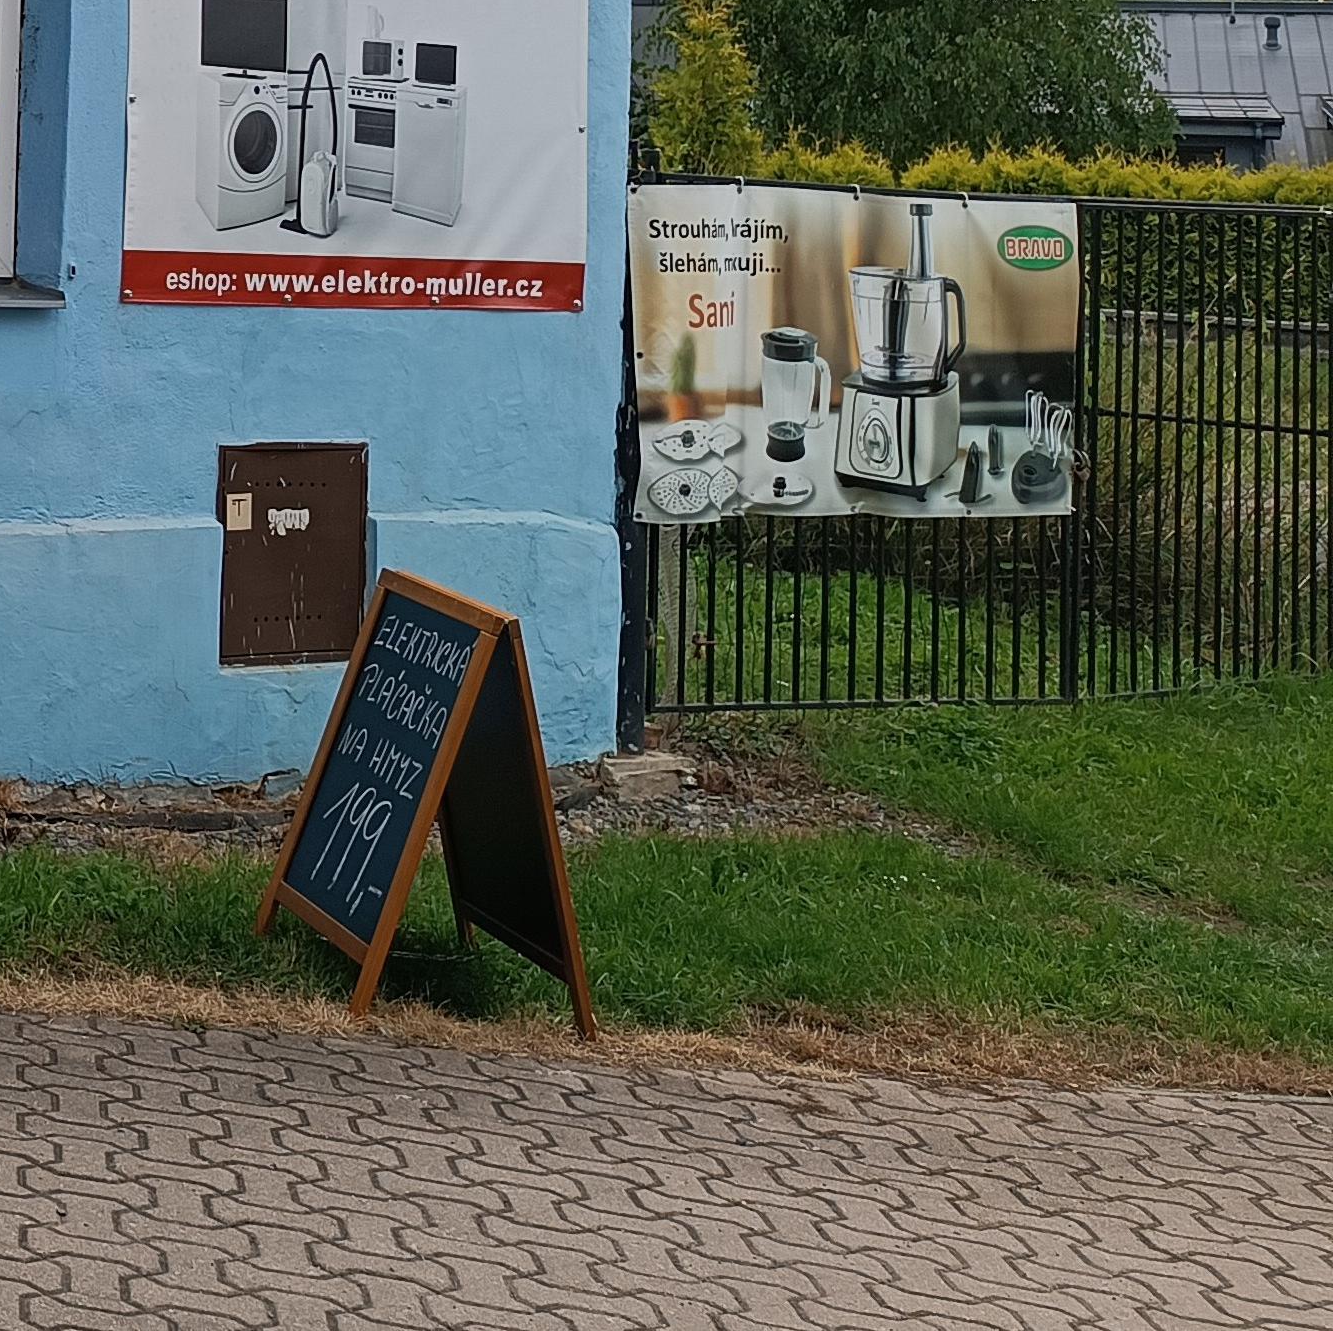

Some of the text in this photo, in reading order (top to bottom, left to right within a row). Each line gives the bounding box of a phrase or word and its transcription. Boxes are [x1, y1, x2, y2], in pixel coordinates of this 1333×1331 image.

[649, 217, 729, 241] Strouhám,
[1004, 236, 1065, 260] BRAVO
[659, 252, 722, 276] šlehám,
[165, 268, 544, 299] eshop: www.elektro-muller.cz
[374, 614, 480, 687] ELEKTRICKÁ
[337, 723, 424, 800] NA HMYZ
[310, 781, 393, 918] 199,-
